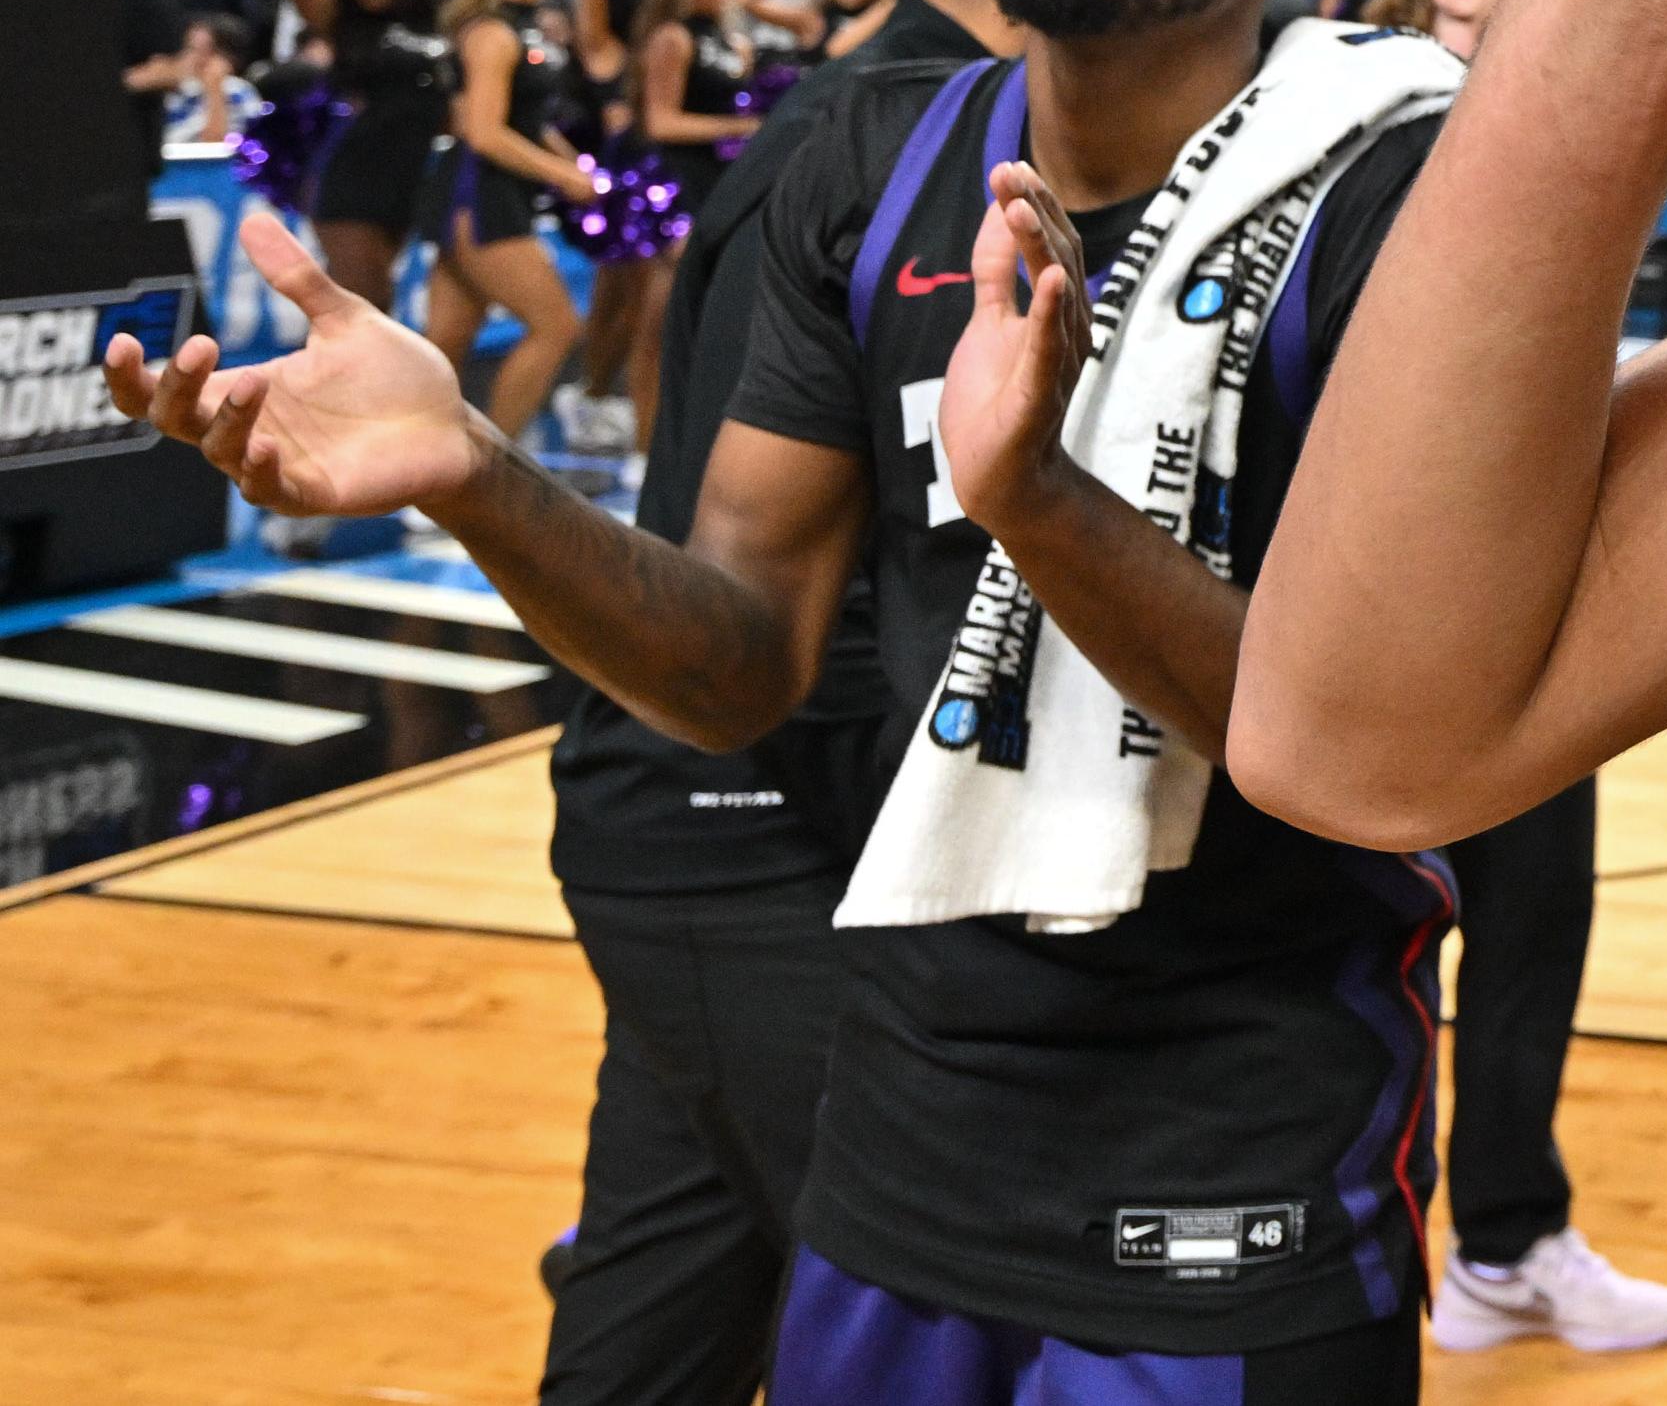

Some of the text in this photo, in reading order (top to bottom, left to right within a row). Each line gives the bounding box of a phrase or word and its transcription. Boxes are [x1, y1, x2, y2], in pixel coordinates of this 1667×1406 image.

[0, 308, 97, 376] RCH
[1147, 423, 1196, 494] THE
[1248, 1219, 1284, 1248] 46
